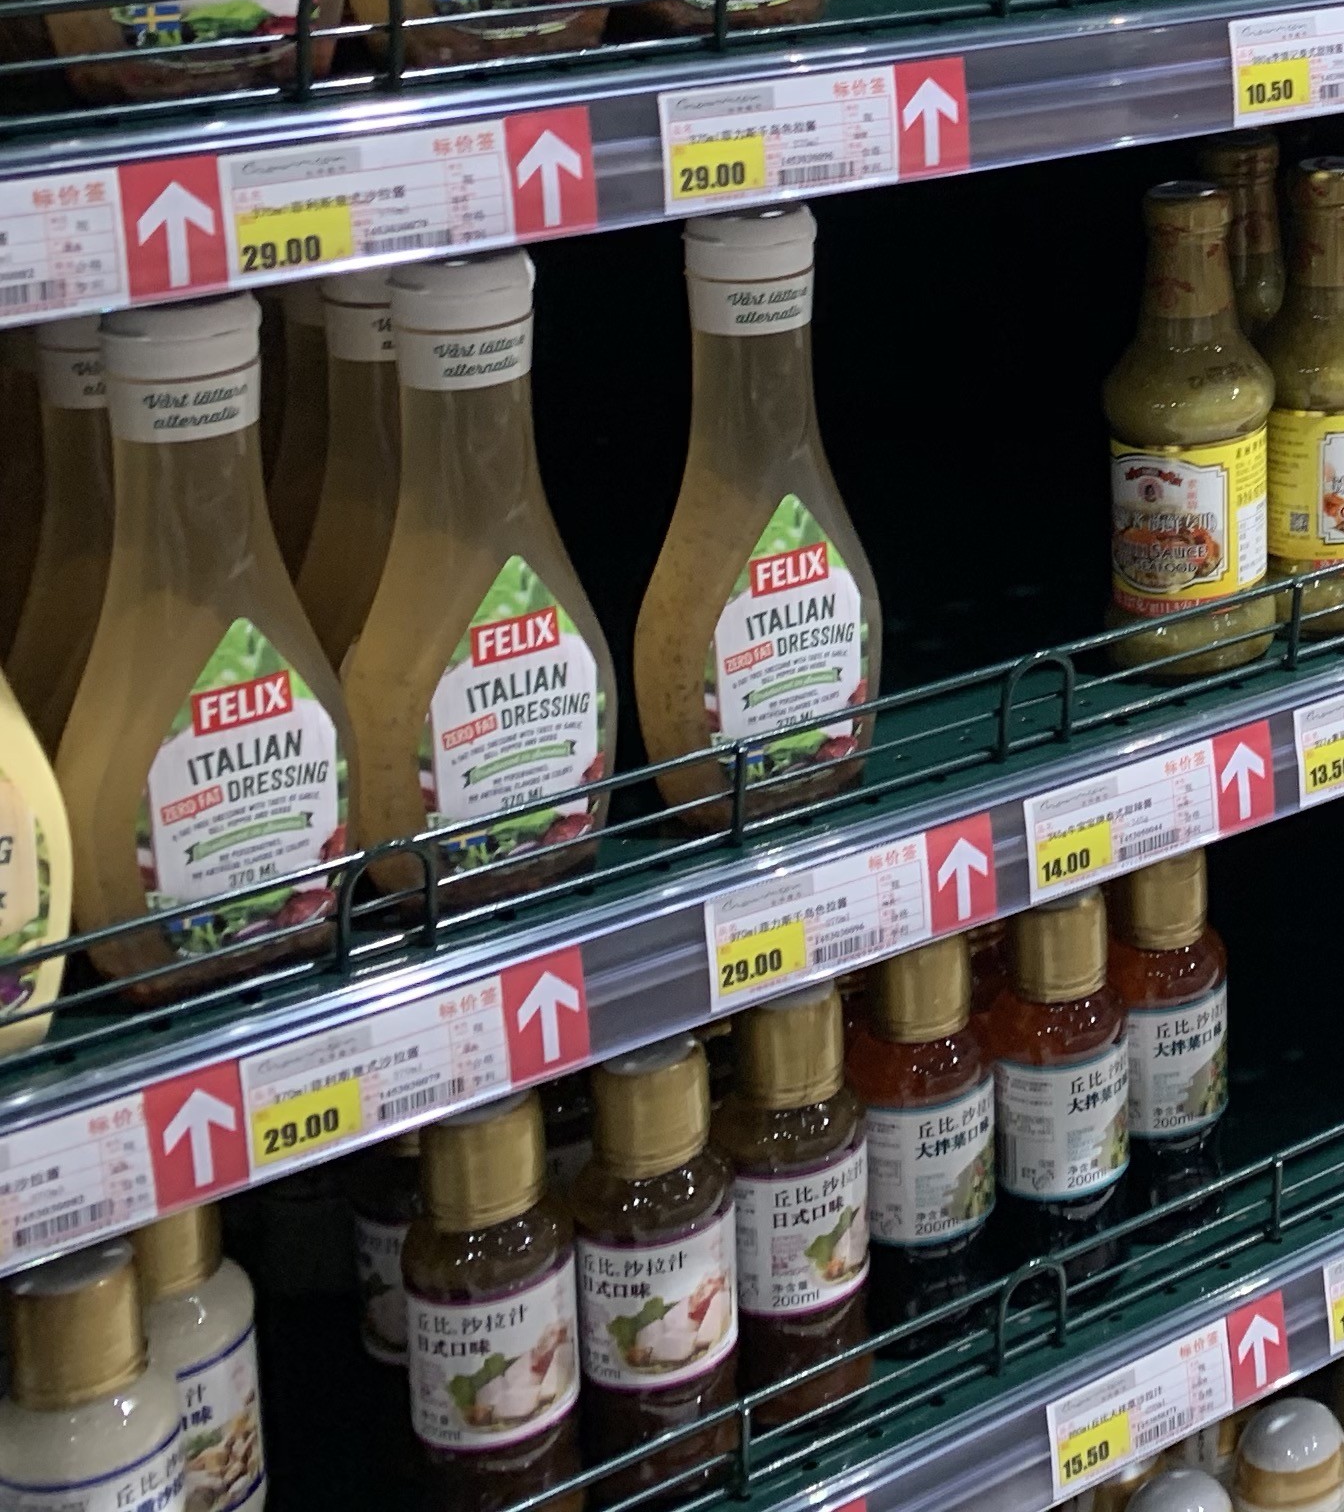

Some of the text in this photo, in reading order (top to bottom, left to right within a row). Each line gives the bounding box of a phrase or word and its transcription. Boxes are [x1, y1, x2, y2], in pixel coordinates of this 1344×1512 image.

[833, 76, 886, 98] 标价签
[1247, 78, 1294, 106] 10.50
[432, 132, 494, 156] 标价签
[32, 180, 105, 209] 标价签
[680, 160, 745, 194] 29.00
[241, 234, 321, 274] 29.00
[757, 547, 825, 592] FELIX
[746, 594, 835, 642] ITALIAN
[478, 612, 555, 661] FELIX
[777, 622, 854, 657] DRESSING
[199, 675, 289, 728] FELIX
[466, 662, 568, 714] ITALIAN
[501, 692, 591, 729] DRESSING
[187, 728, 304, 786] ITALIAN
[1163, 749, 1206, 776] 标价签
[162, 798, 197, 823] ZERO
[199, 789, 221, 810] FAT
[228, 760, 331, 803] DRESSING
[867, 843, 918, 871] 标价签
[1041, 847, 1091, 883] 14.00
[228, 861, 280, 890] 370 ML
[721, 947, 783, 989] 29.00
[438, 987, 497, 1020] 标价签
[263, 1106, 339, 1156] 29.00
[772, 1197, 846, 1230] 日式口味
[772, 1287, 822, 1309] 200ml
[416, 1337, 492, 1359] 日式口味
[1062, 1439, 1110, 1480] 15.50
